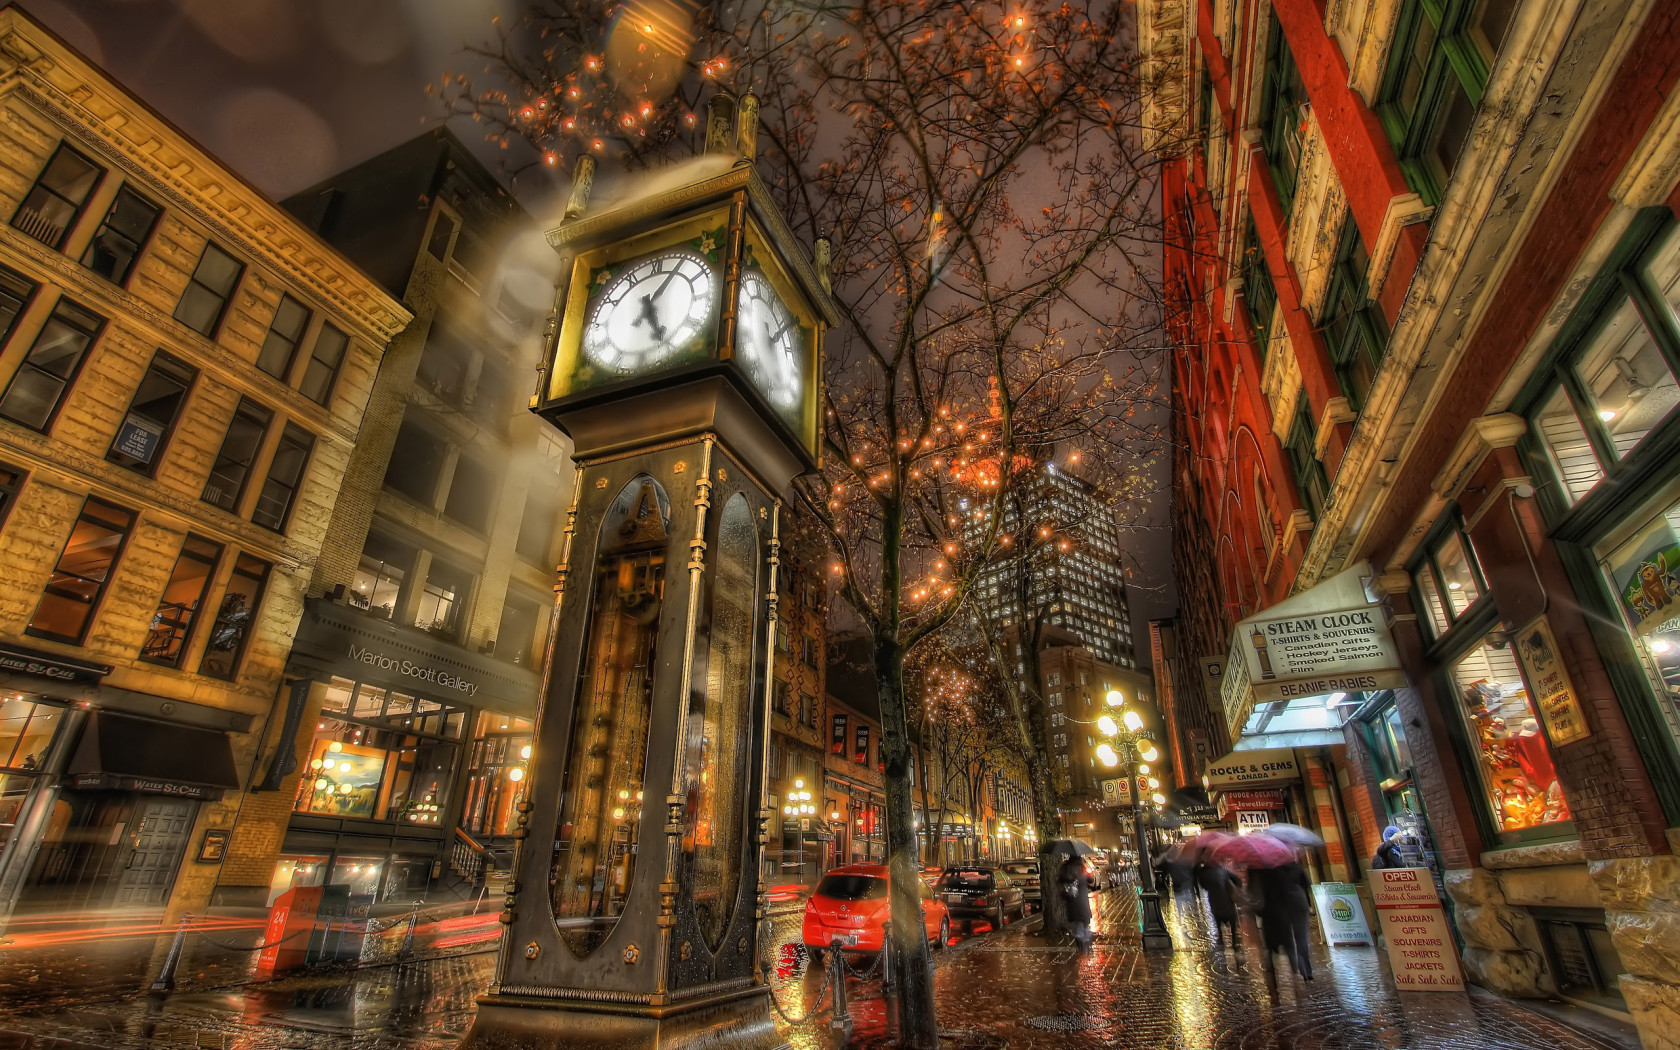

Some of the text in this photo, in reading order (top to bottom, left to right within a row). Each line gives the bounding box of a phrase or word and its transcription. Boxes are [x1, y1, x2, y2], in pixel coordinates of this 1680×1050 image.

[135, 428, 148, 438] FOR
[129, 432, 149, 445] LEASE
[1267, 611, 1373, 636] STEAM CLOCK
[1271, 626, 1376, 646] T-SHIRTS & SOUVENIRS
[1284, 636, 1371, 652] Canadian Gifts
[1286, 643, 1379, 659] Hockey Jerseys
[1288, 650, 1384, 667] Smoked Salmon
[347, 644, 479, 697] Marion Scott Gallery
[1290, 666, 1315, 674] Film
[1280, 675, 1377, 697] BEANIE BABIES
[1210, 761, 1293, 776] ROCKS & GEMS
[1236, 772, 1269, 781] CANADA
[1254, 790, 1279, 798] GELATO
[1239, 813, 1267, 824] ATM
[1385, 872, 1416, 882] OPEN
[1383, 883, 1421, 892] Steam Clock
[1406, 892, 1438, 901] Souvenirs
[273, 911, 285, 924] 24
[1389, 914, 1434, 923] CANADIAN
[1401, 926, 1427, 935] GIFTS
[1393, 938, 1442, 947] SOUVENIRS
[1401, 950, 1440, 959] T-SHIRTS
[1404, 962, 1445, 971] JACKETS
[1396, 974, 1460, 986] Sale Sale Sale
